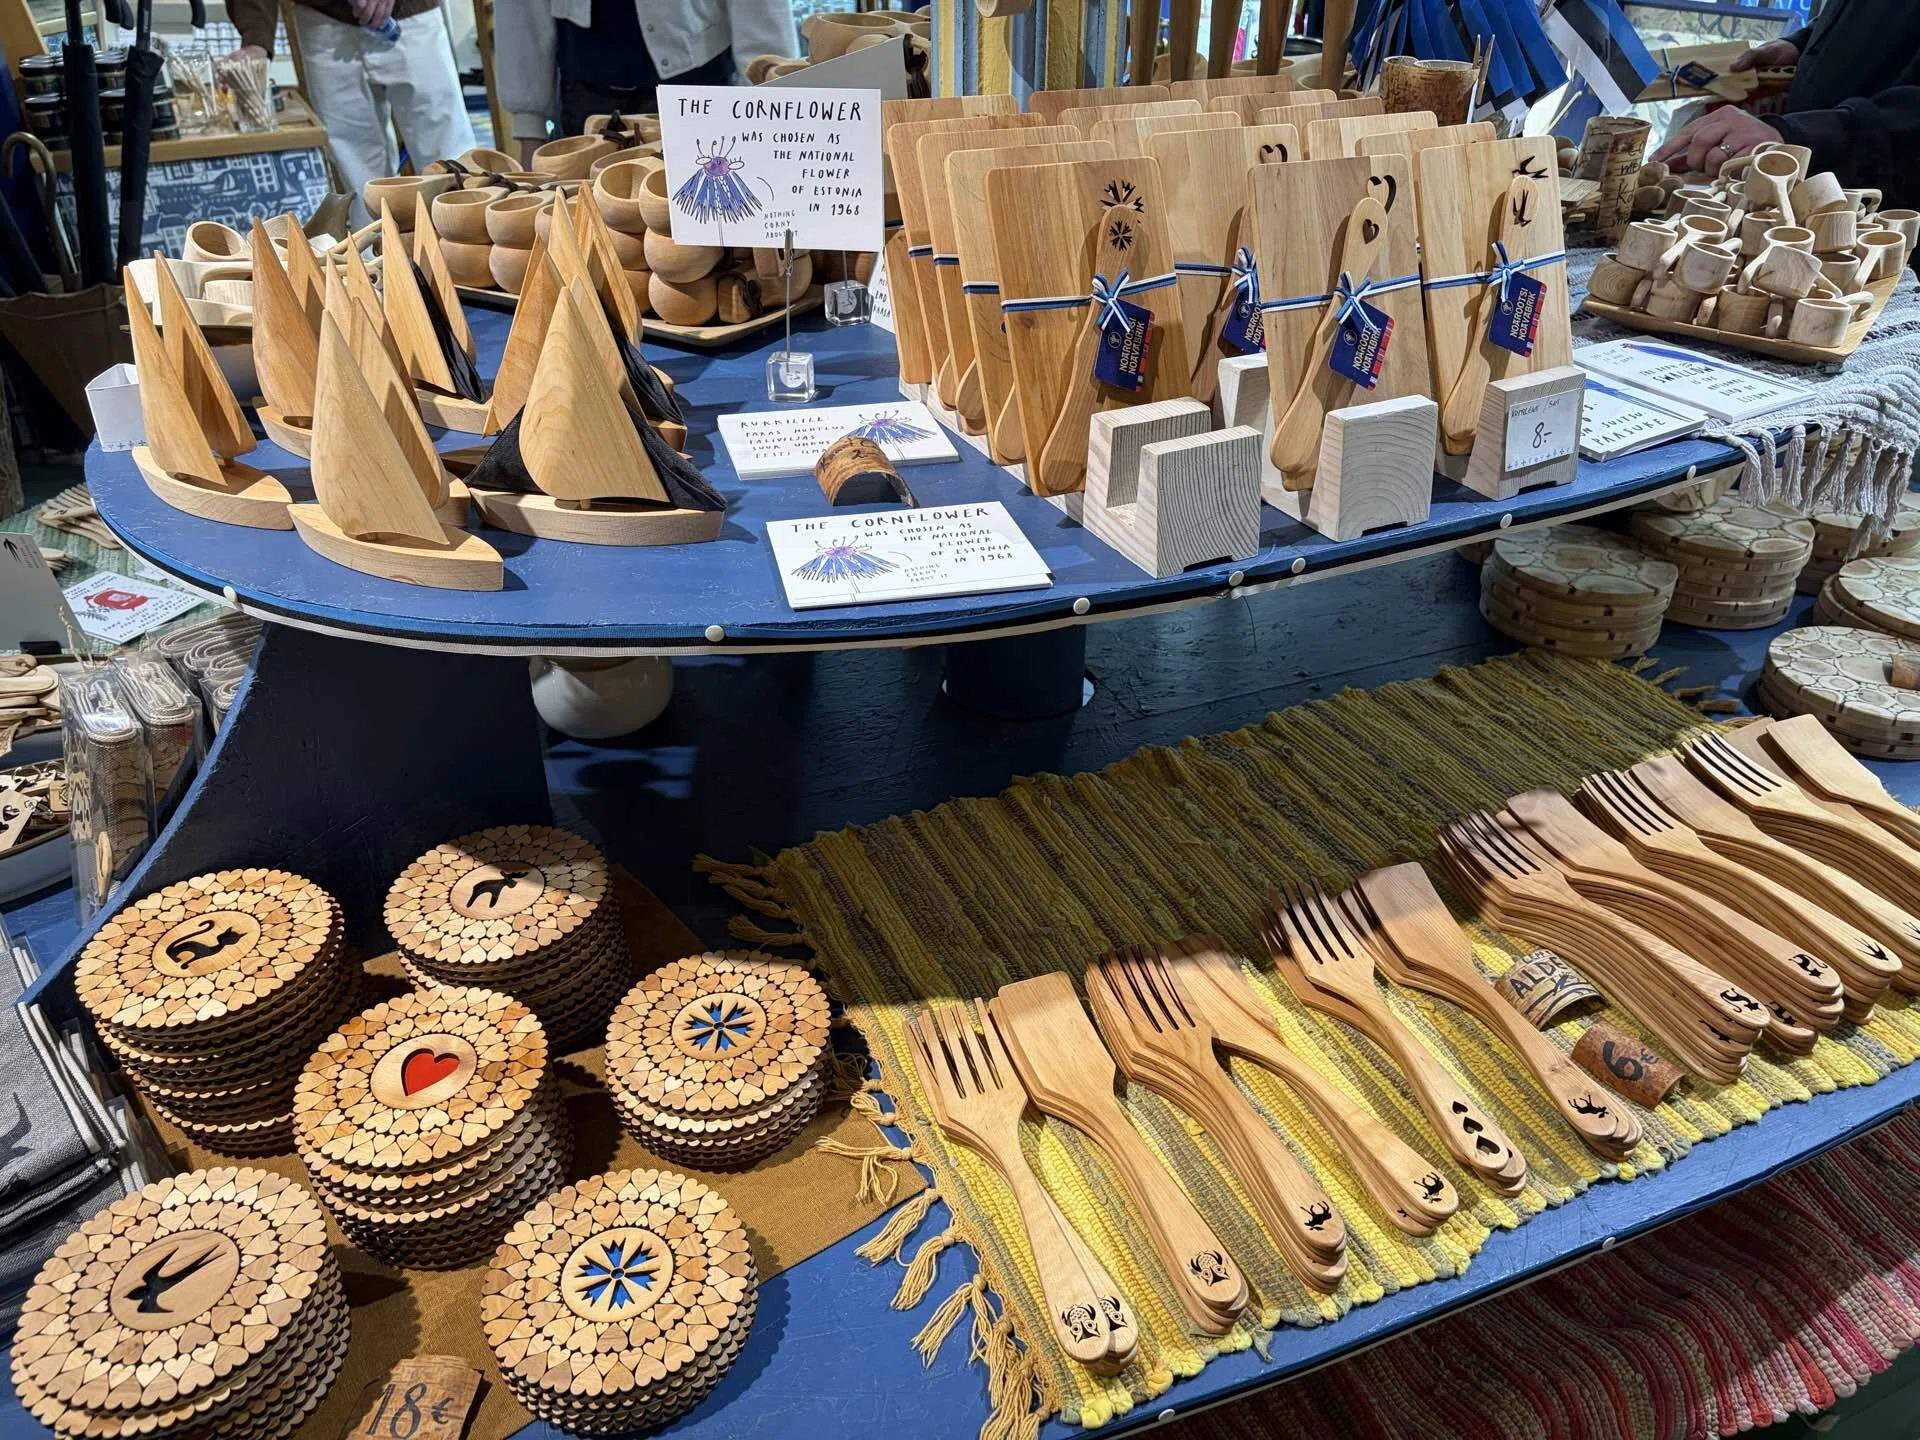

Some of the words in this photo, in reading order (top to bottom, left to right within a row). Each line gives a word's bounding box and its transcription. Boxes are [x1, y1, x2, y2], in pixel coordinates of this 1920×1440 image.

[678, 98, 713, 117] THE
[732, 99, 862, 121] CORNFLOWER
[741, 131, 763, 143] WAS
[773, 132, 815, 144] CHOSEN
[827, 133, 841, 145] AS
[773, 150, 792, 160] THE
[798, 150, 855, 162] NATIONAL
[802, 167, 850, 179] FLOWER
[791, 185, 804, 195] OF
[813, 185, 862, 197] ESTONIA
[809, 203, 820, 213] IN
[831, 204, 860, 216] 1968
[1509, 287, 1529, 338] NOAROOTSI
[1518, 291, 1537, 341] NOAVABRIK
[1119, 317, 1137, 372] NOAROOSI
[1652, 366, 1715, 384] SWALLOW
[792, 521, 829, 533] THE
[851, 507, 989, 528] CORNFLOWER
[899, 525, 945, 535] CHOSEN
[932, 529, 993, 540] NATIONAL
[938, 537, 992, 548] FLOWER
[956, 543, 1011, 555] ESTONIA
[980, 552, 1013, 562] 1968
[1510, 956, 1568, 999] ALDE
